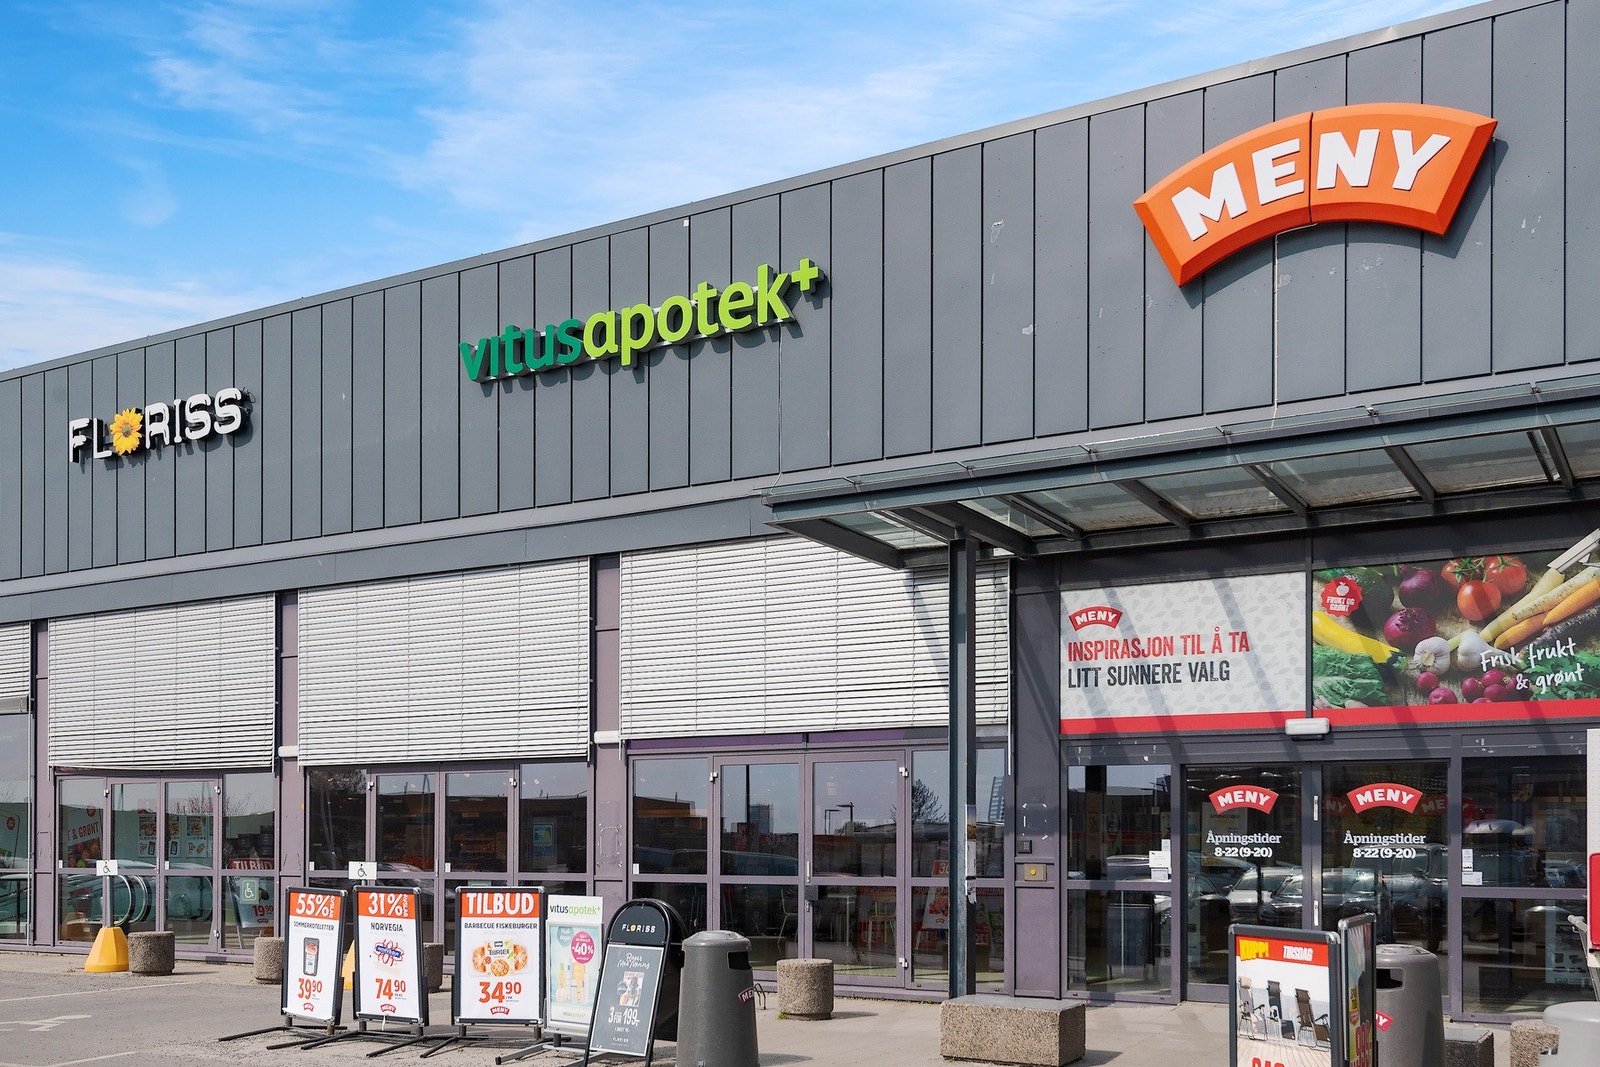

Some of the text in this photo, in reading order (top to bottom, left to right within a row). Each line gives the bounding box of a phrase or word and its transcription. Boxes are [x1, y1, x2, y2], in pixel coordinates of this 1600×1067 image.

[1171, 129, 1451, 241] MENY
[1075, 610, 1117, 626] MENY
[1068, 626, 1250, 662] INSPIRASJON TIL Å TA
[1480, 637, 1576, 672] Frisk frukt
[1068, 660, 1230, 688] LITT SUNNERE VALG
[1515, 663, 1585, 695] & grønt
[1217, 790, 1270, 807] MENY
[1355, 789, 1414, 806] MENY
[1206, 829, 1281, 846] Åpningstider
[1343, 829, 1426, 845] Åpningstider
[295, 893, 329, 917] 55%
[368, 893, 403, 917] 31%
[466, 892, 534, 915] TILBUD
[371, 922, 404, 932] NORVEGIA
[622, 924, 655, 933] FLORISS
[572, 942, 594, 955] -40%
[1239, 939, 1314, 962] KUPP! TIRSDAG
[608, 1006, 615, 1023] 3
